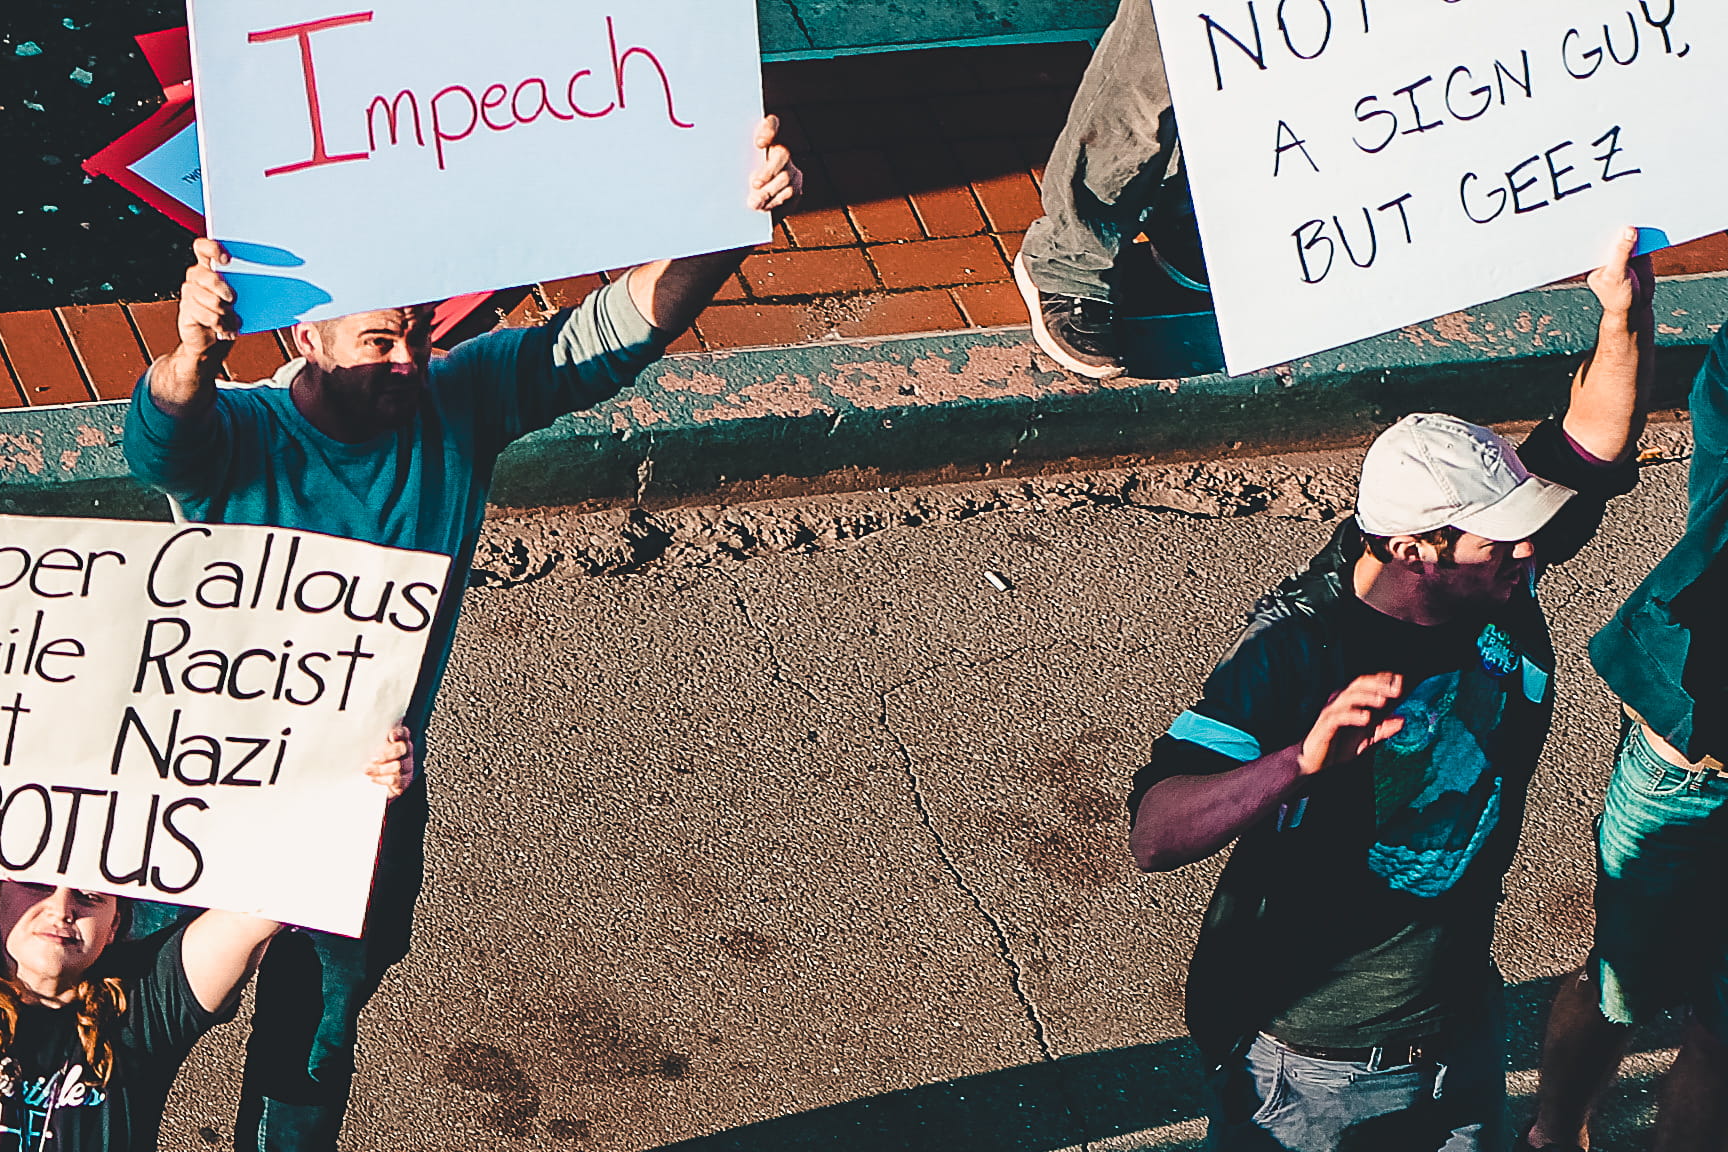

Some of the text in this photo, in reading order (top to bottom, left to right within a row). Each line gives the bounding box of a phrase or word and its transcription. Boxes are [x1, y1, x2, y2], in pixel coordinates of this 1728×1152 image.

[246, 10, 695, 178] Impeach
[1272, 119, 1320, 177] A
[1352, 49, 1532, 154] SIGN
[1291, 125, 1642, 285] BUT GEEZ
[145, 526, 439, 634] Callous
[132, 616, 375, 711] Racist
[110, 705, 292, 787] Nazi
